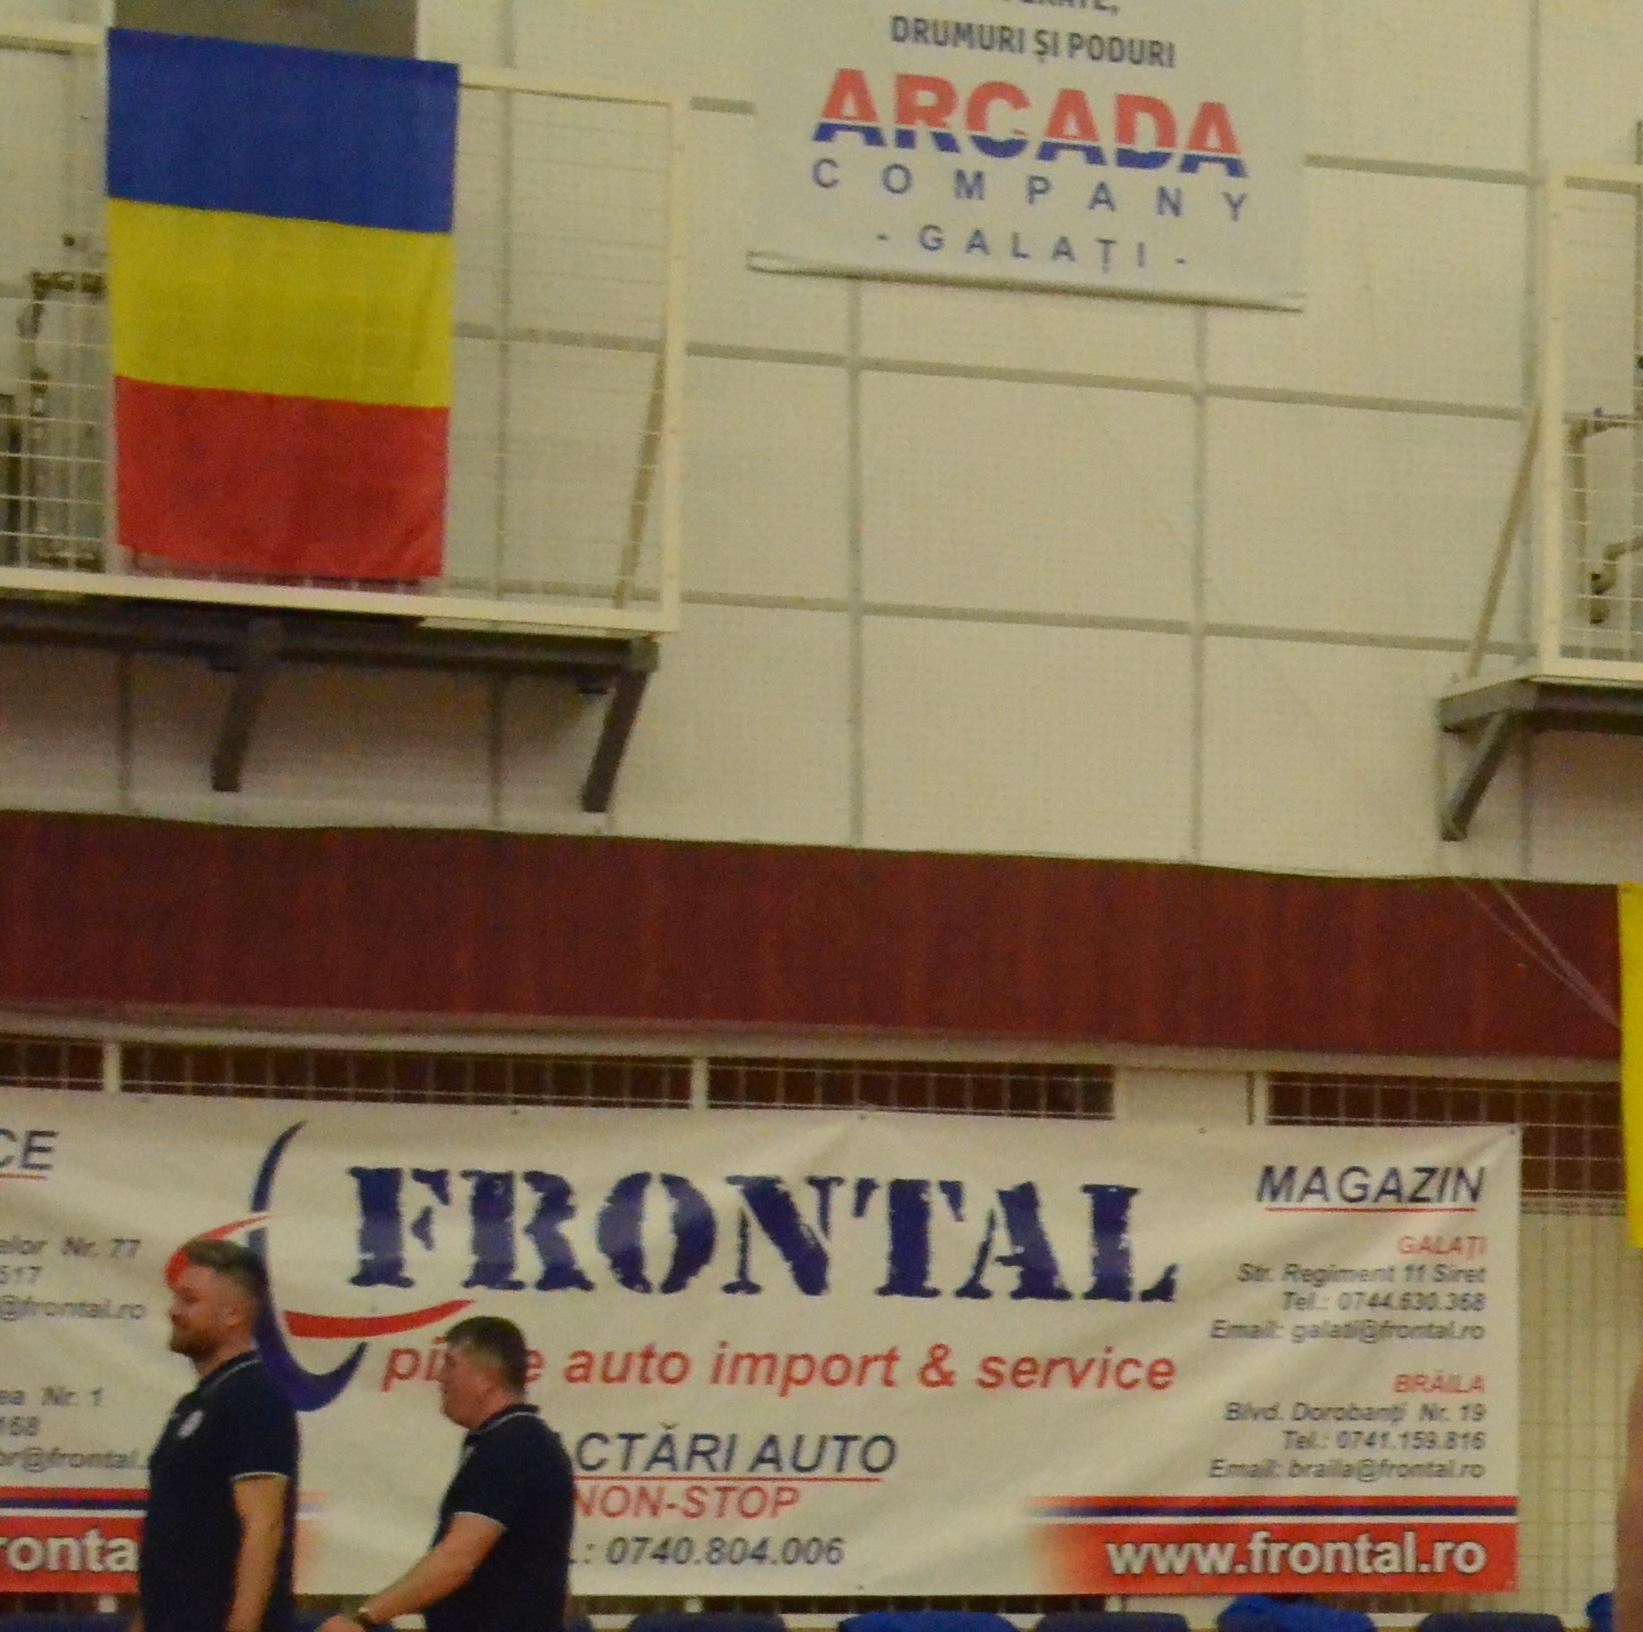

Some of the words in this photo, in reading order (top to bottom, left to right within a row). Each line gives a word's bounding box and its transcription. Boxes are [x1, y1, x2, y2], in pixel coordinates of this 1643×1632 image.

[891, 15, 1024, 54] DRUMURI
[1067, 32, 1176, 68] PODURI
[812, 67, 1249, 180] ARCADA
[811, 157, 1249, 222] COMPANY
[1256, 1165, 1486, 1203] MAGAZIN
[347, 1166, 1179, 1302] FRONTAL
[1281, 1263, 1395, 1287] Regiment
[1432, 1263, 1487, 1282] Siret
[564, 1342, 690, 1387] auto
[709, 1340, 900, 1398] import
[917, 1343, 957, 1388] &
[976, 1346, 1177, 1391] service
[557, 1421, 738, 1473] CTĂRI
[748, 1433, 898, 1474] AUTO
[572, 1485, 801, 1519] NON-STOP
[605, 1536, 846, 1566] 0740.804.006
[1105, 1530, 1489, 1576] www.frontal.ro
